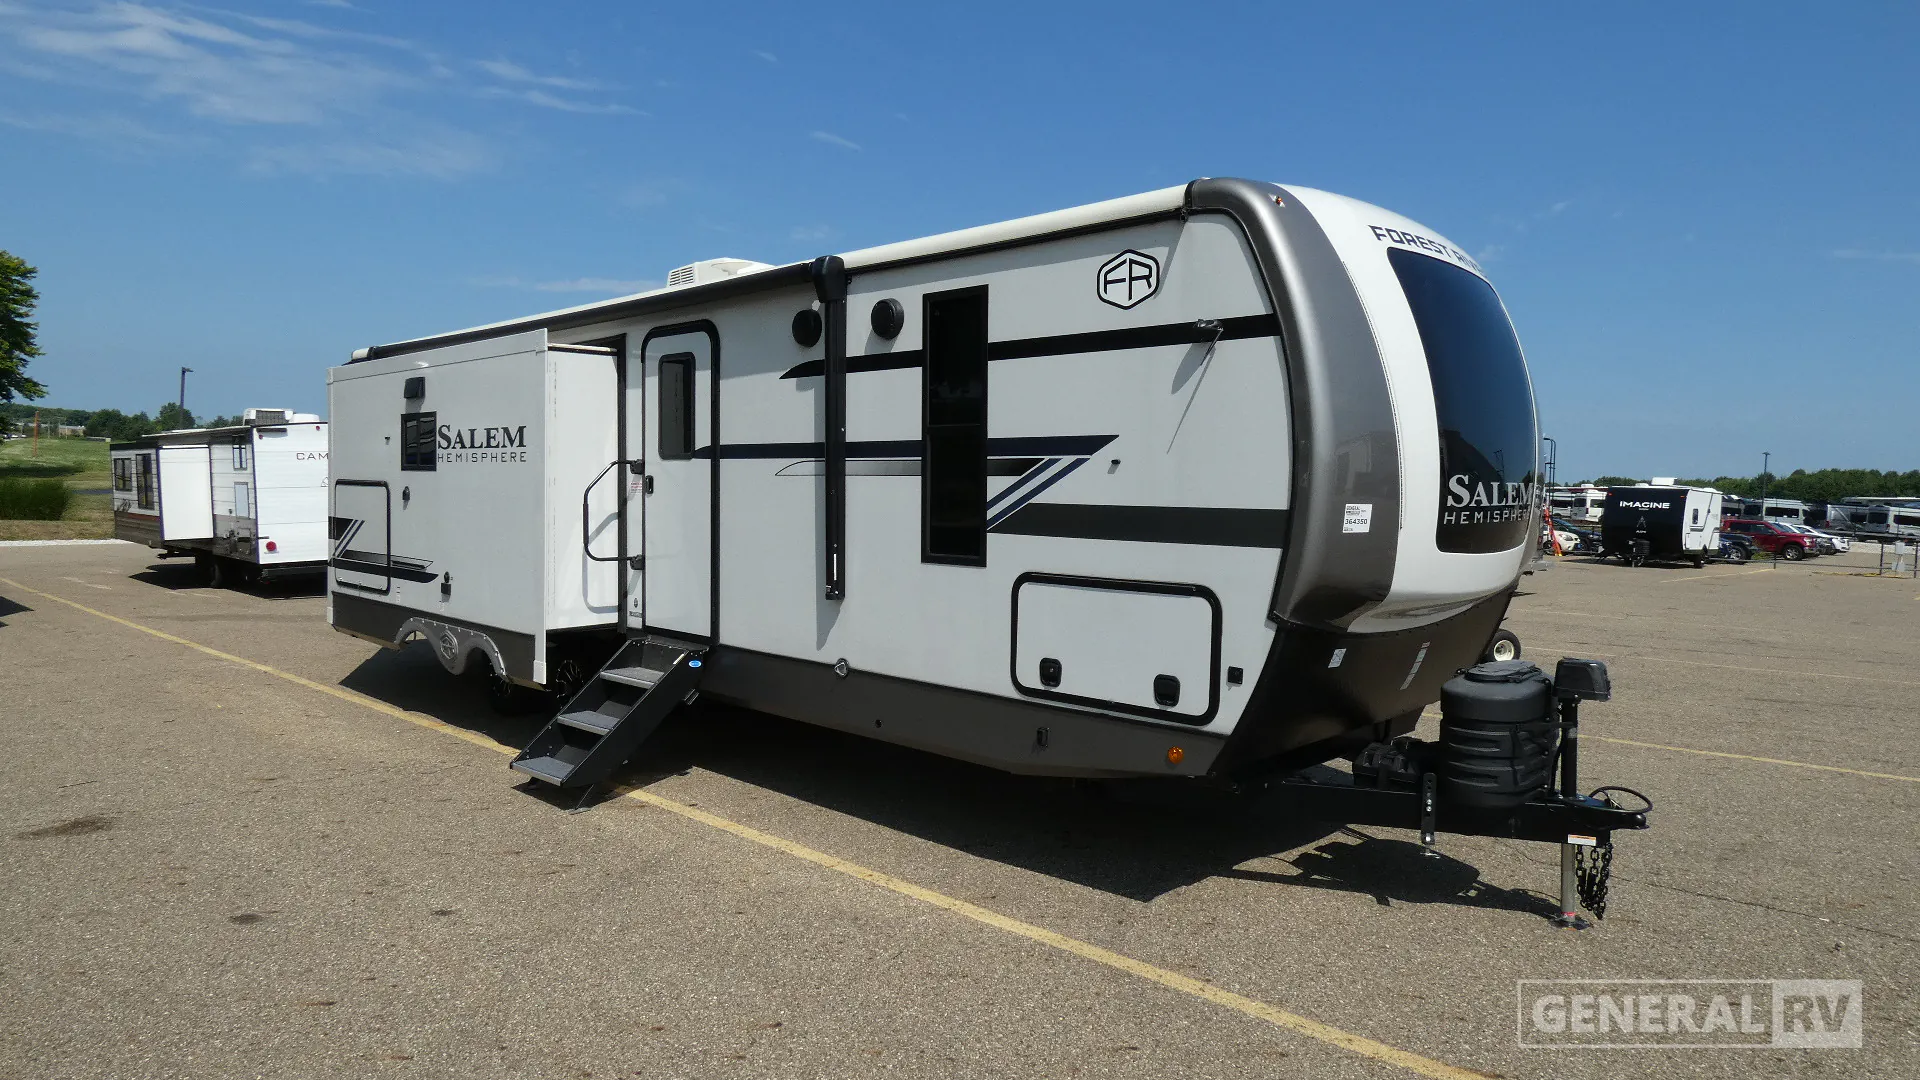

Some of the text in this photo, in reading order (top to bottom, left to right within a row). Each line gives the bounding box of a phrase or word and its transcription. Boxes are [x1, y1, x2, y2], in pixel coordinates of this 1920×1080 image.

[1368, 225, 1451, 258] FOREST
[437, 424, 527, 450] SALEM
[296, 452, 329, 461] CAM
[437, 451, 527, 463] HEMISPHERE
[1446, 474, 1534, 508] SALEM
[1619, 500, 1671, 509] IMAGINE
